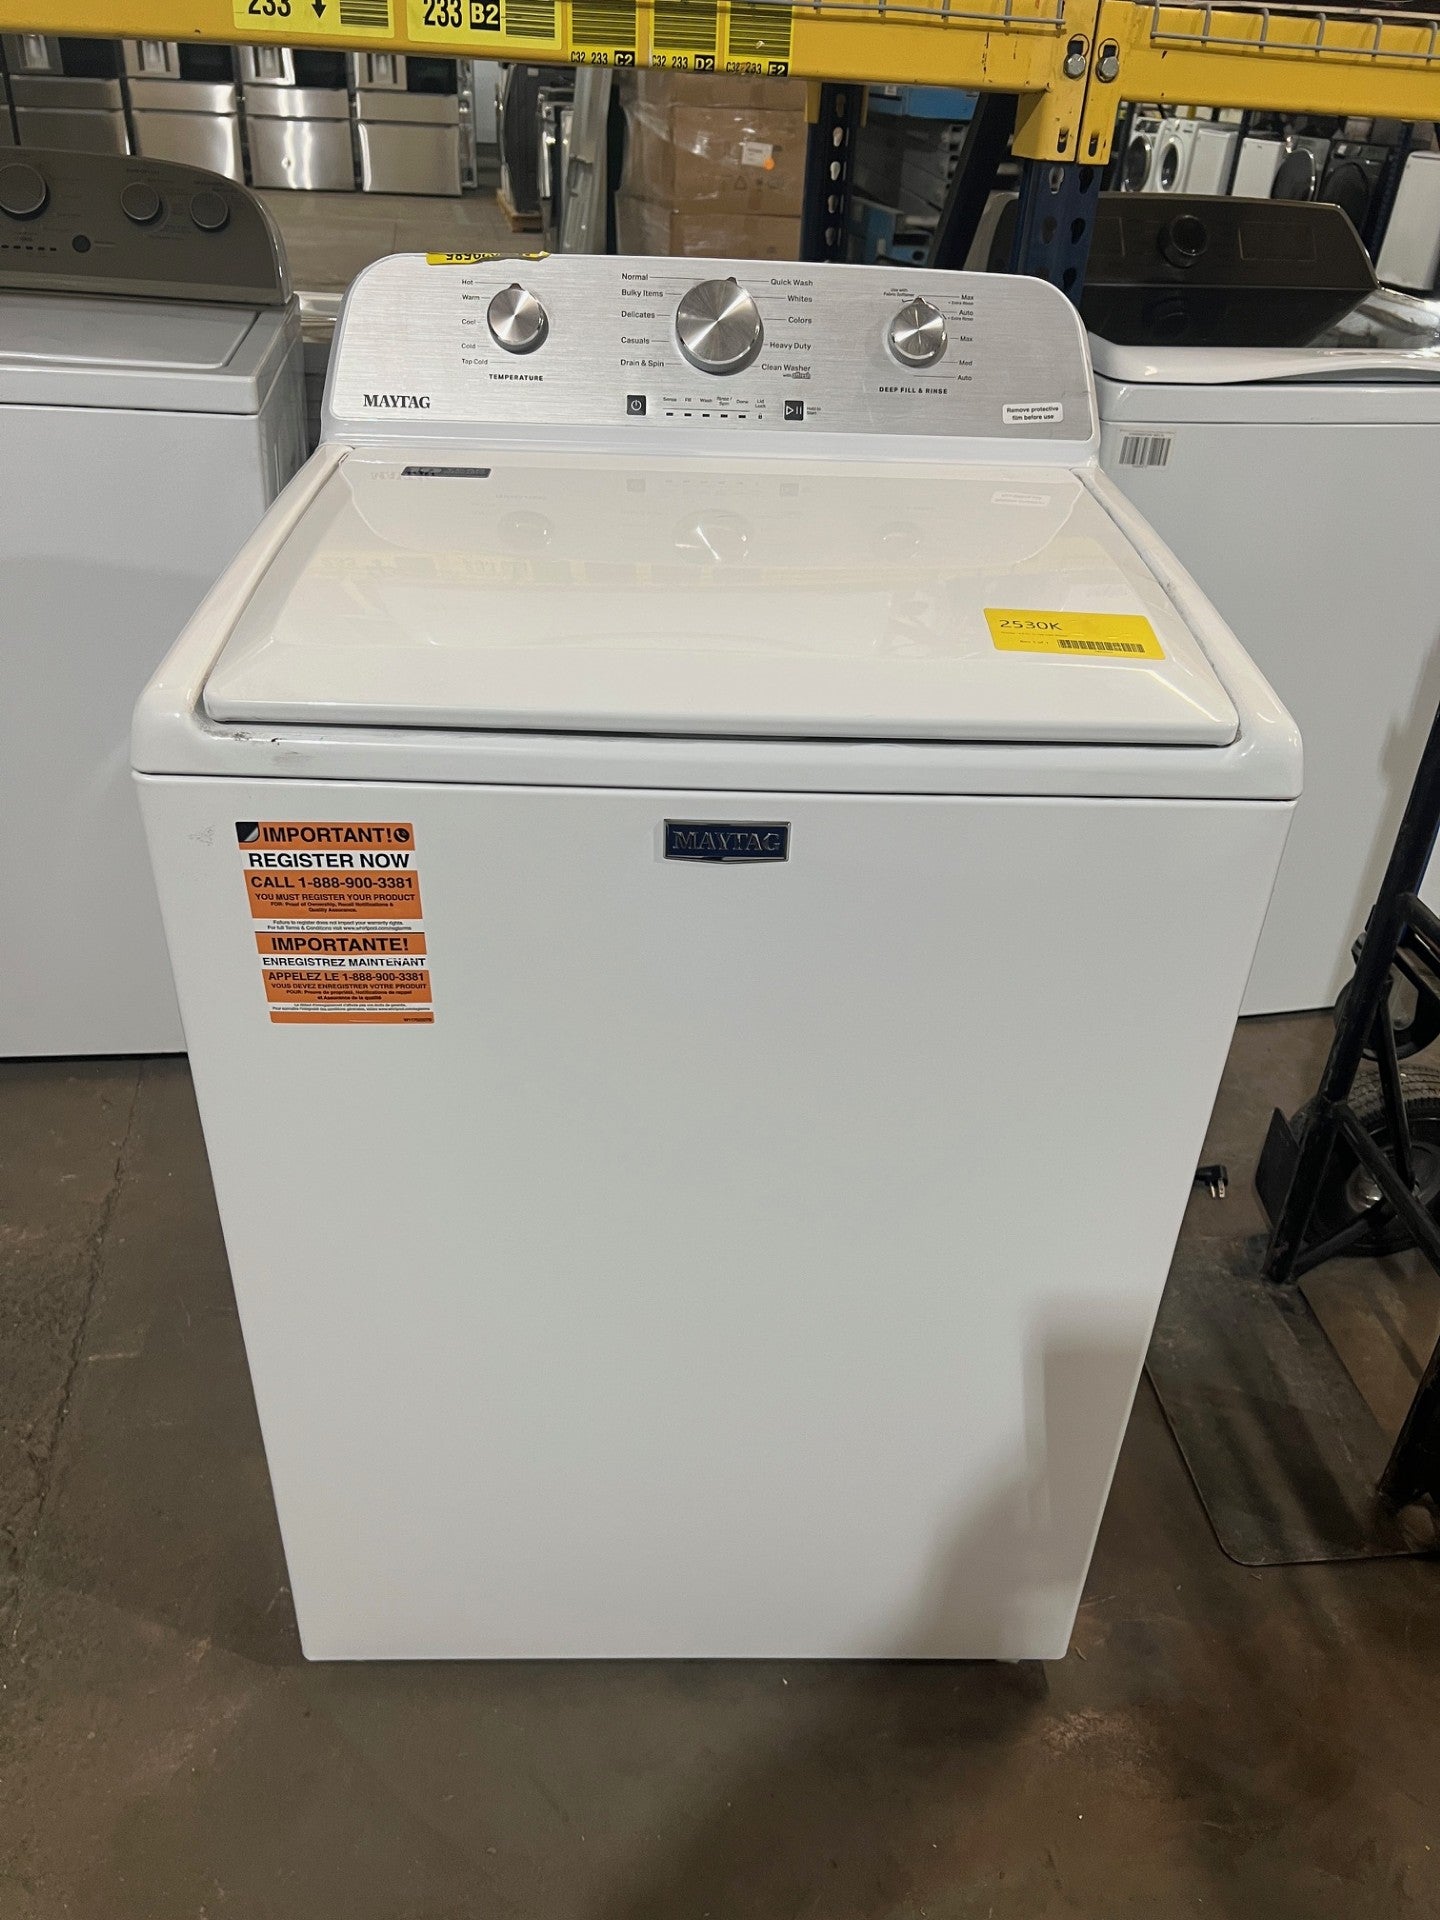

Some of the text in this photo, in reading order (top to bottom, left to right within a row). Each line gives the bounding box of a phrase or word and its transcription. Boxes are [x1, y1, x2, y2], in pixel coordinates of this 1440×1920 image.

[424, 0, 500, 27] 233 B2
[571, 52, 633, 66] C32 233 C2
[652, 54, 714, 70] C32 233 D2
[726, 61, 740, 72] C32
[768, 62, 786, 76] E2
[622, 289, 641, 297] Bulky
[770, 342, 792, 350] Heavy
[363, 394, 430, 409] MAYTAG
[1000, 619, 1063, 631] 2530K
[263, 827, 392, 843] IMPORTANT!
[672, 831, 780, 850] MAYTAG
[249, 853, 410, 868] REGISTER NOW
[251, 876, 413, 888] CALL 1-888-900-3381
[271, 937, 408, 951] IMPORTANTE!
[263, 958, 426, 967] ENREGISTREZ MAINTENANT
[268, 972, 424, 981] APPELEZ LE 1-888-900-3381
